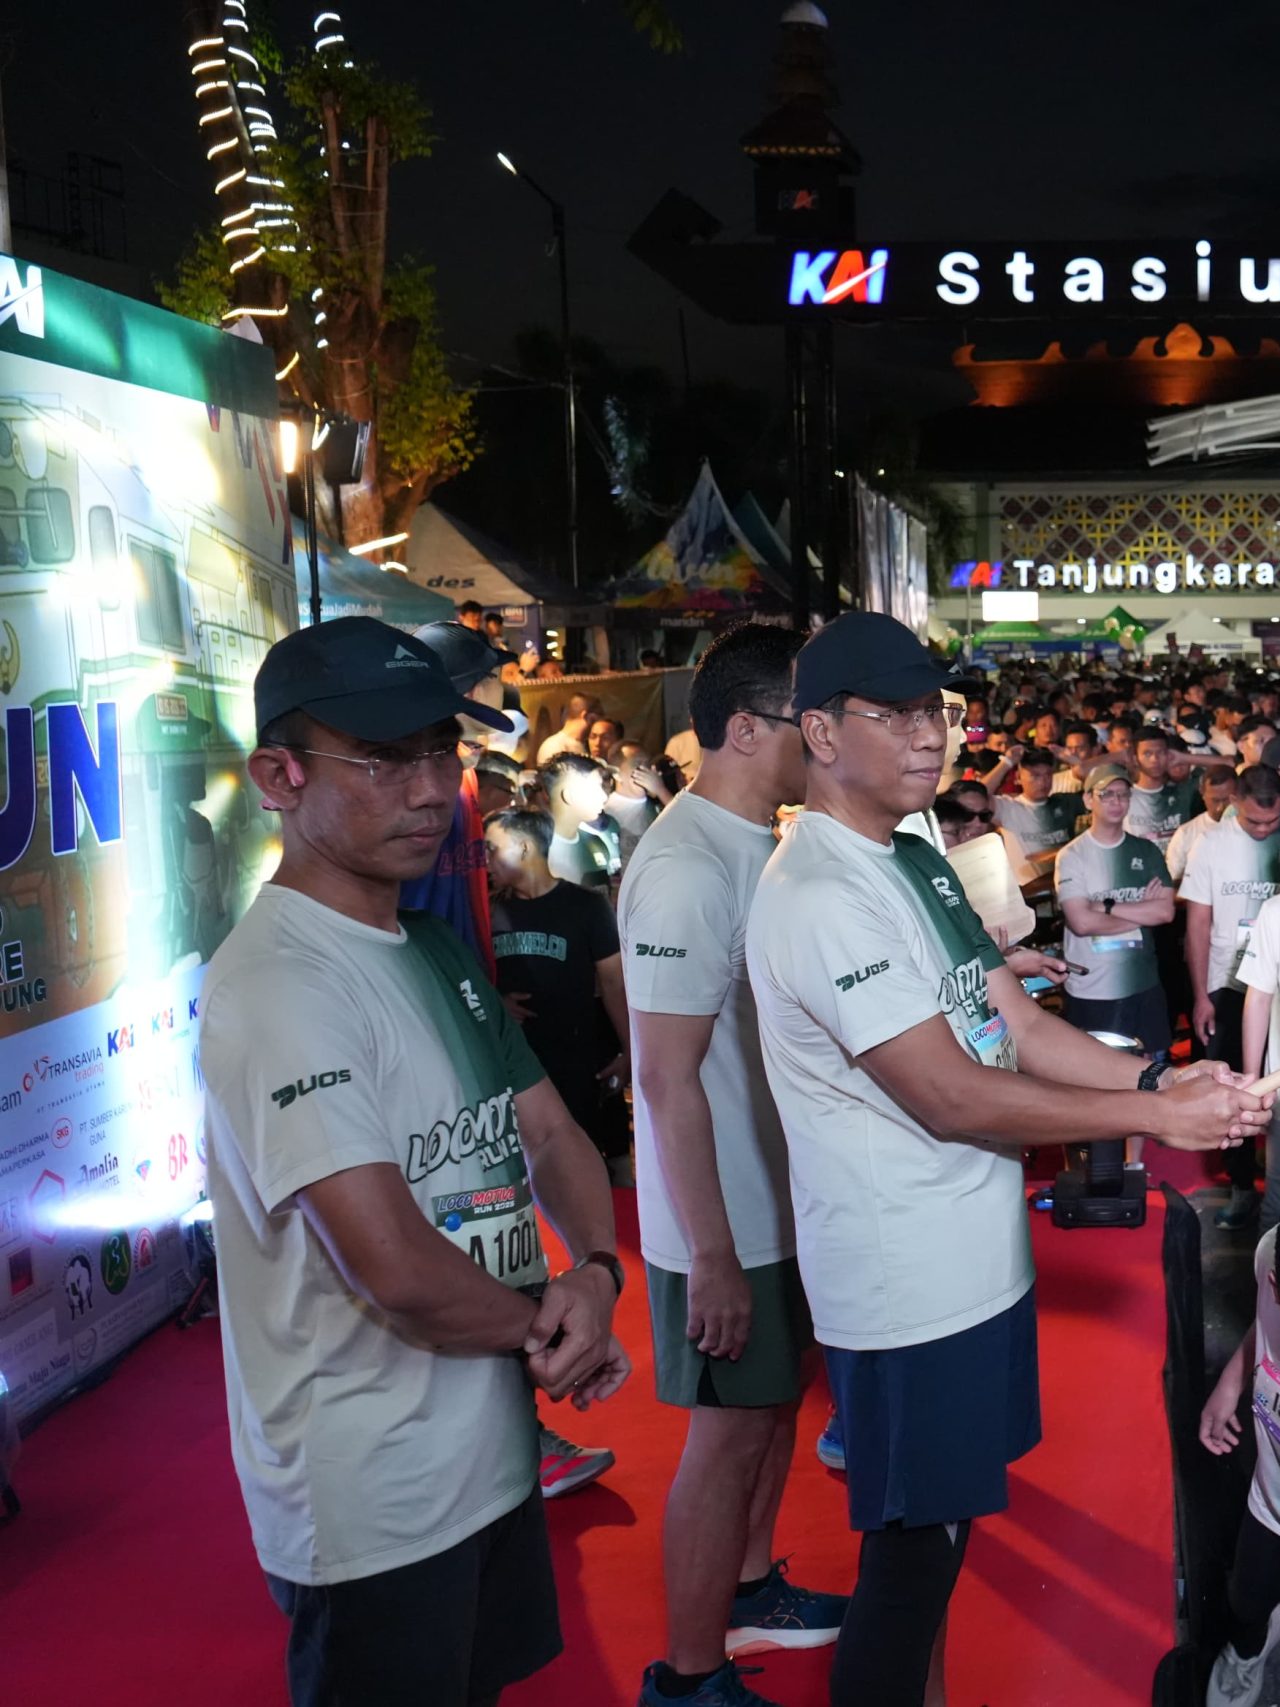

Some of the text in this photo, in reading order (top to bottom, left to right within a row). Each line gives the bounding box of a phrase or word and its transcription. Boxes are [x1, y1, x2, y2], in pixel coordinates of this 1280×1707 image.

[788, 249, 888, 305] KAI
[950, 561, 1002, 588] KAI
[636, 943, 687, 959] DUOS
[835, 959, 891, 992] DUOS
[107, 1024, 135, 1057] KAI
[47, 1047, 102, 1080] TRANSAVIA
[75, 1061, 105, 1084] trading
[271, 1068, 352, 1110] DUOS
[78, 1152, 119, 1186] Amalia
[474, 1204, 494, 1214] RUN
